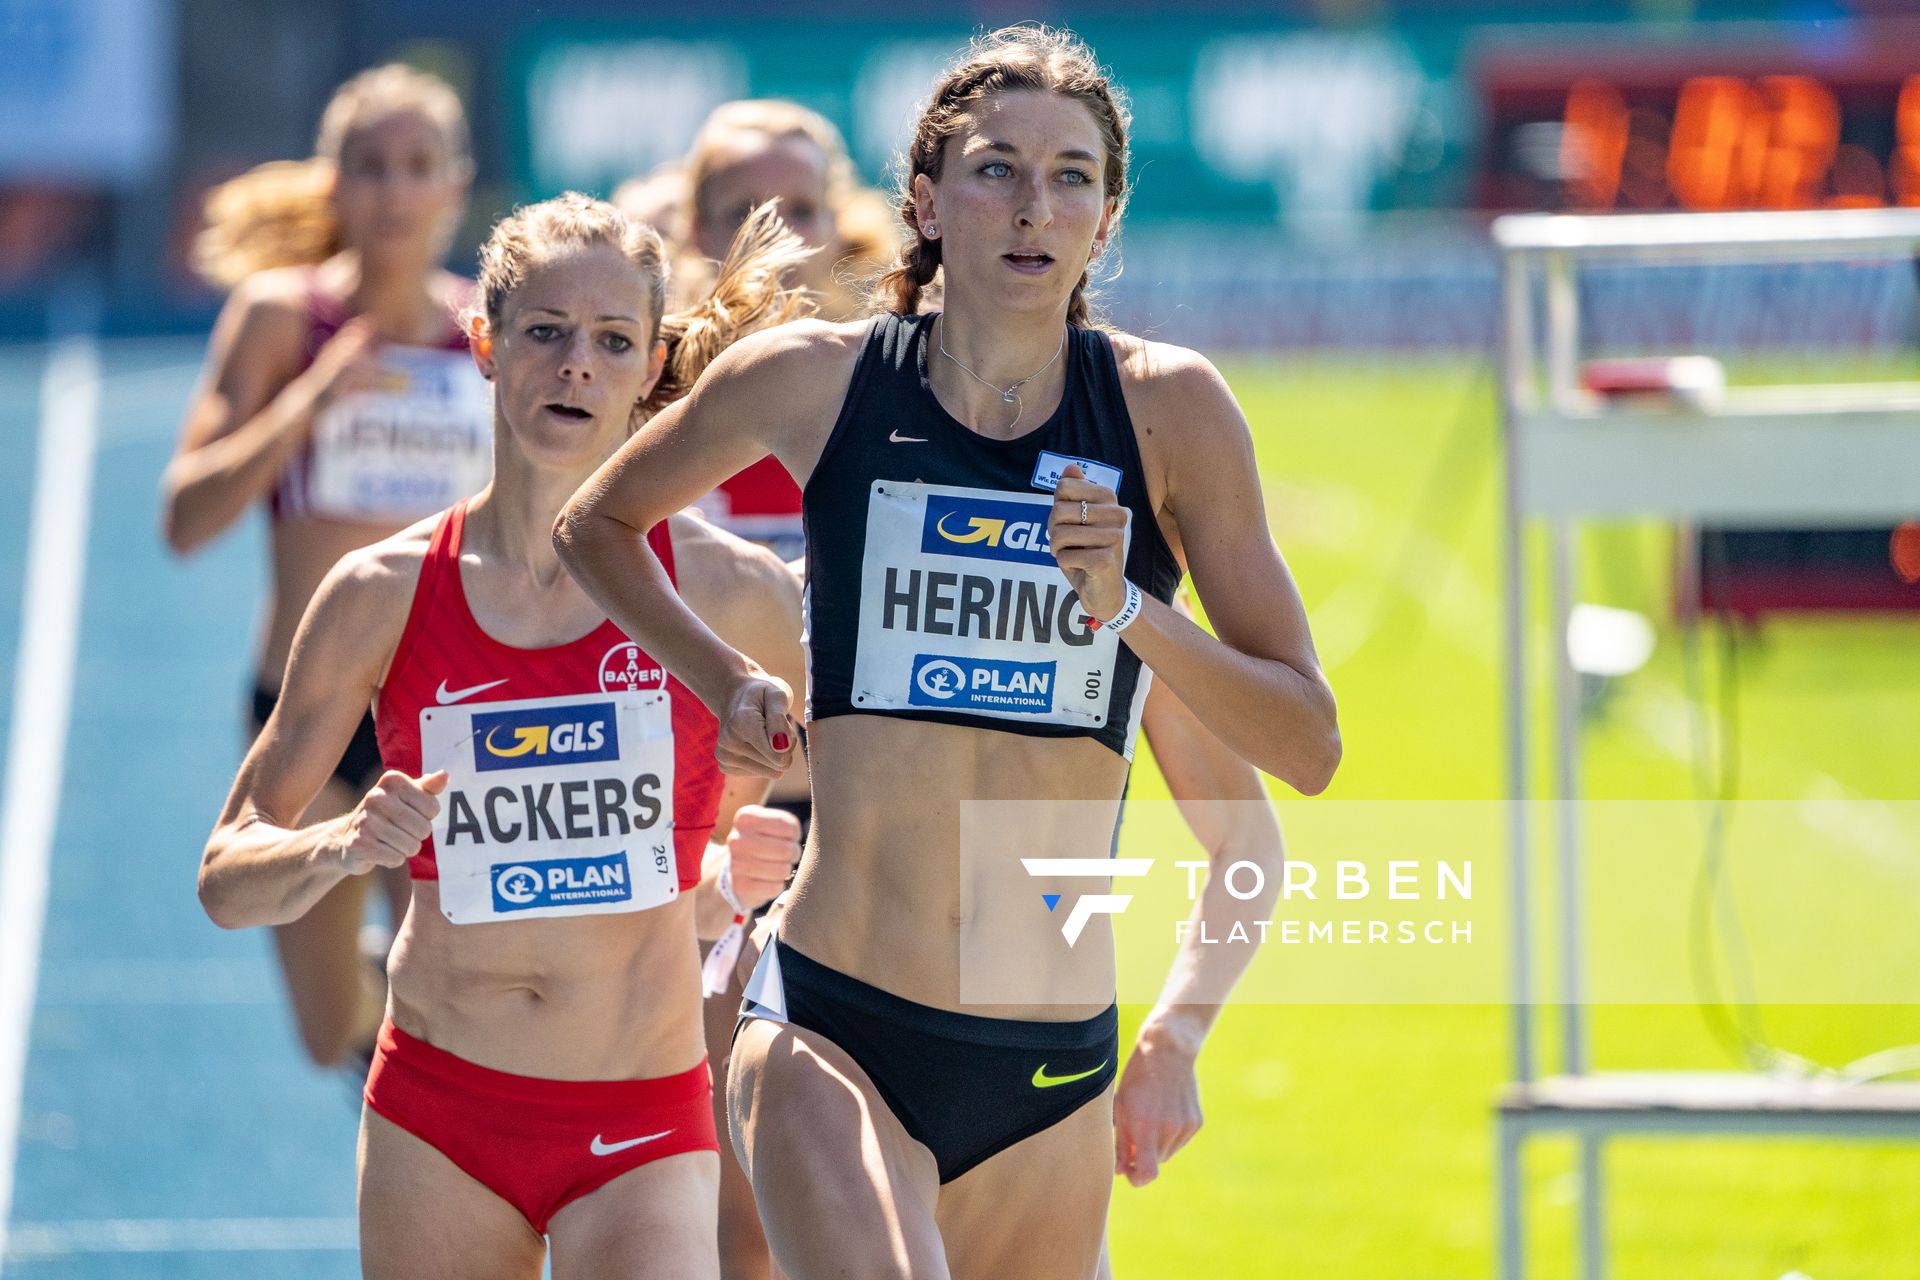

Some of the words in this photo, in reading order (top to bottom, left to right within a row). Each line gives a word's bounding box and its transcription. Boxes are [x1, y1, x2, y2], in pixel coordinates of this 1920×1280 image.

[882, 567, 1095, 646] HERING
[605, 669, 661, 683] BAYER
[626, 648, 639, 691] BAYE
[972, 668, 1049, 694] PLAN
[1084, 669, 1102, 700] 100
[971, 694, 1047, 706] INTERNATIONAL
[550, 721, 605, 753] GLS
[445, 773, 662, 845] ACKERS
[652, 845, 669, 874] 267
[547, 863, 624, 890] PLAN
[550, 888, 626, 900] INTERNATIONAL
